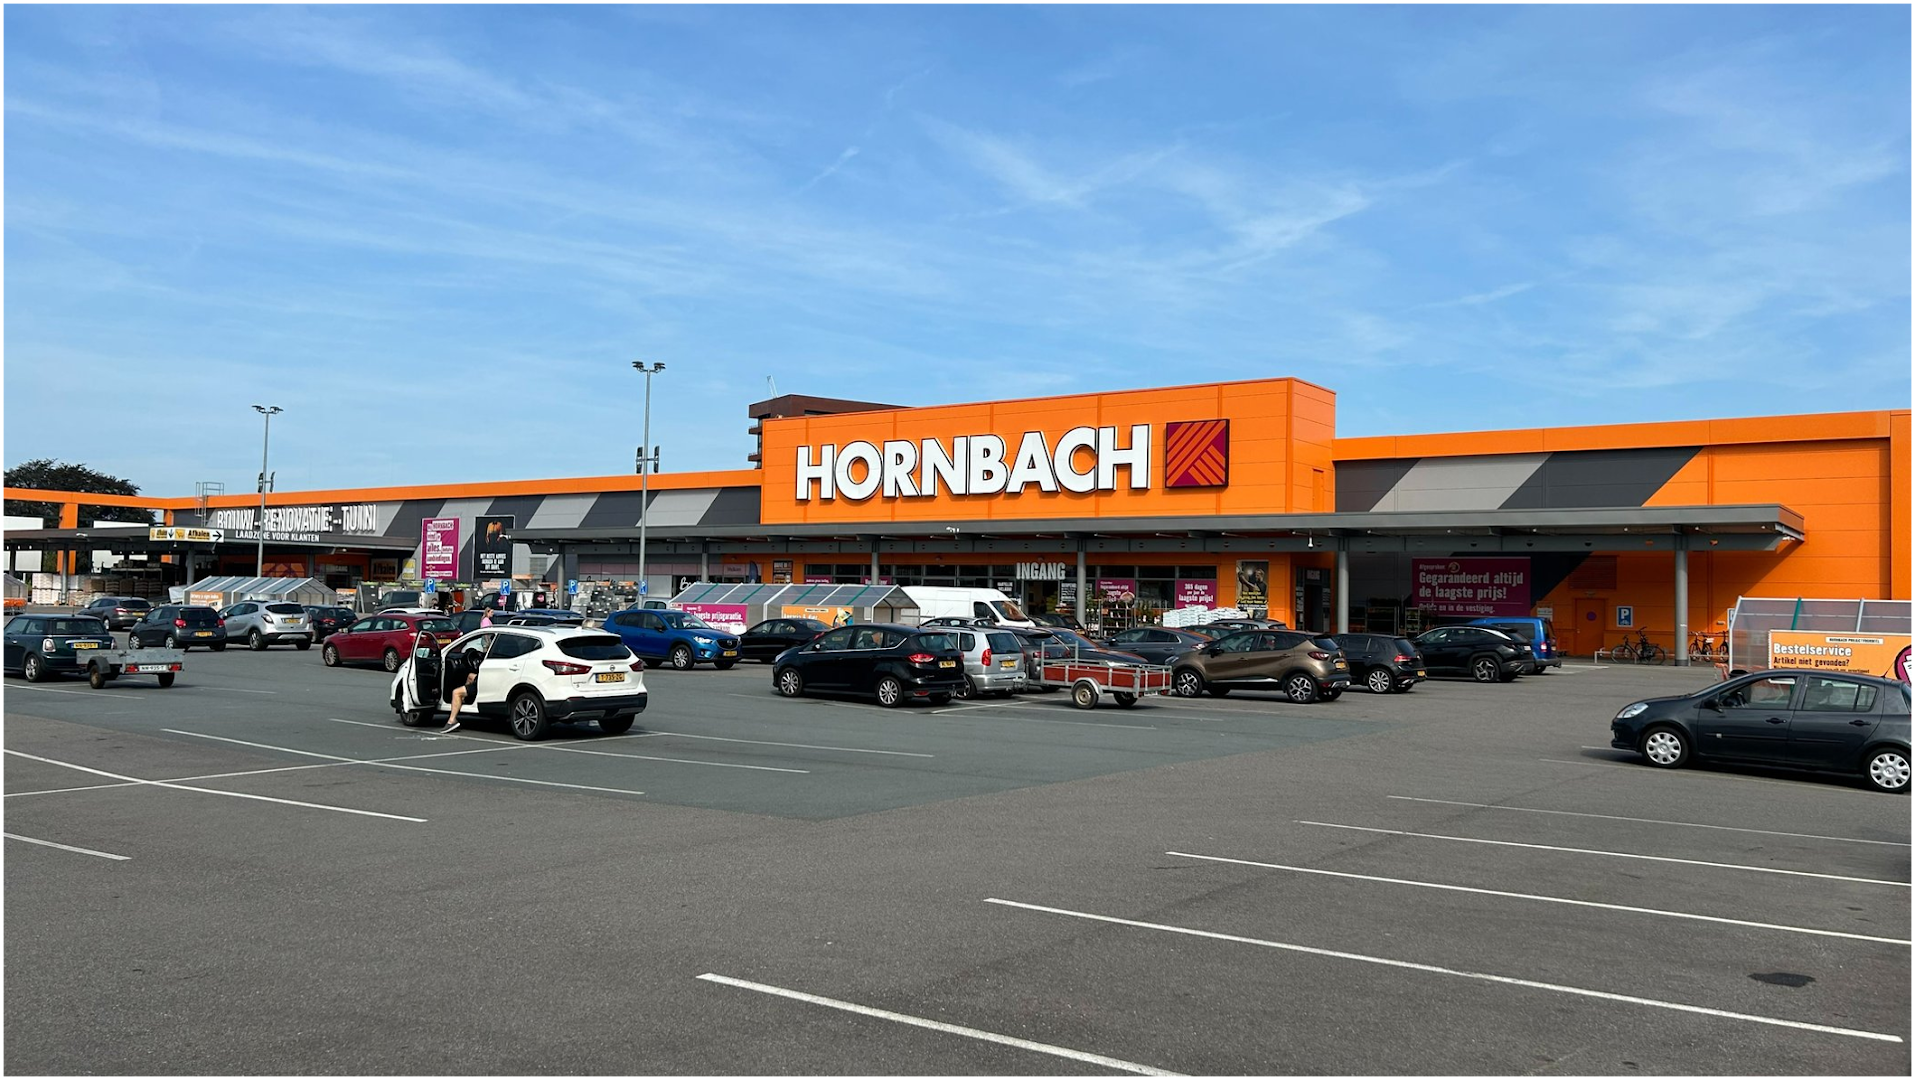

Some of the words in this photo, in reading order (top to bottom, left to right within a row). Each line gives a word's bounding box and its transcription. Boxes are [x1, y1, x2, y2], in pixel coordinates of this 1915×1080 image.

[796, 424, 1151, 501] HORNBACH
[235, 530, 270, 539] LAADZONE
[272, 532, 289, 541] VOOR
[291, 533, 319, 542] KLANTEN
[1016, 562, 1066, 580] INGANG
[1419, 572, 1490, 586] Gegarandeerd
[1493, 572, 1524, 587] altijd
[1194, 584, 1208, 592] dagen
[1419, 586, 1431, 597] de
[1435, 586, 1473, 600] laagste
[1477, 586, 1507, 601] prijs!
[1179, 594, 1198, 603] laagste
[1199, 595, 1214, 603] prijs!
[1456, 603, 1464, 611] de
[1466, 604, 1495, 613] vestiging.
[1621, 606, 1630, 619] P
[1773, 643, 1852, 656] Bestelservice
[1773, 656, 1797, 665] Artikel
[1798, 657, 1812, 665] niet
[1814, 658, 1850, 667] gevonden?
